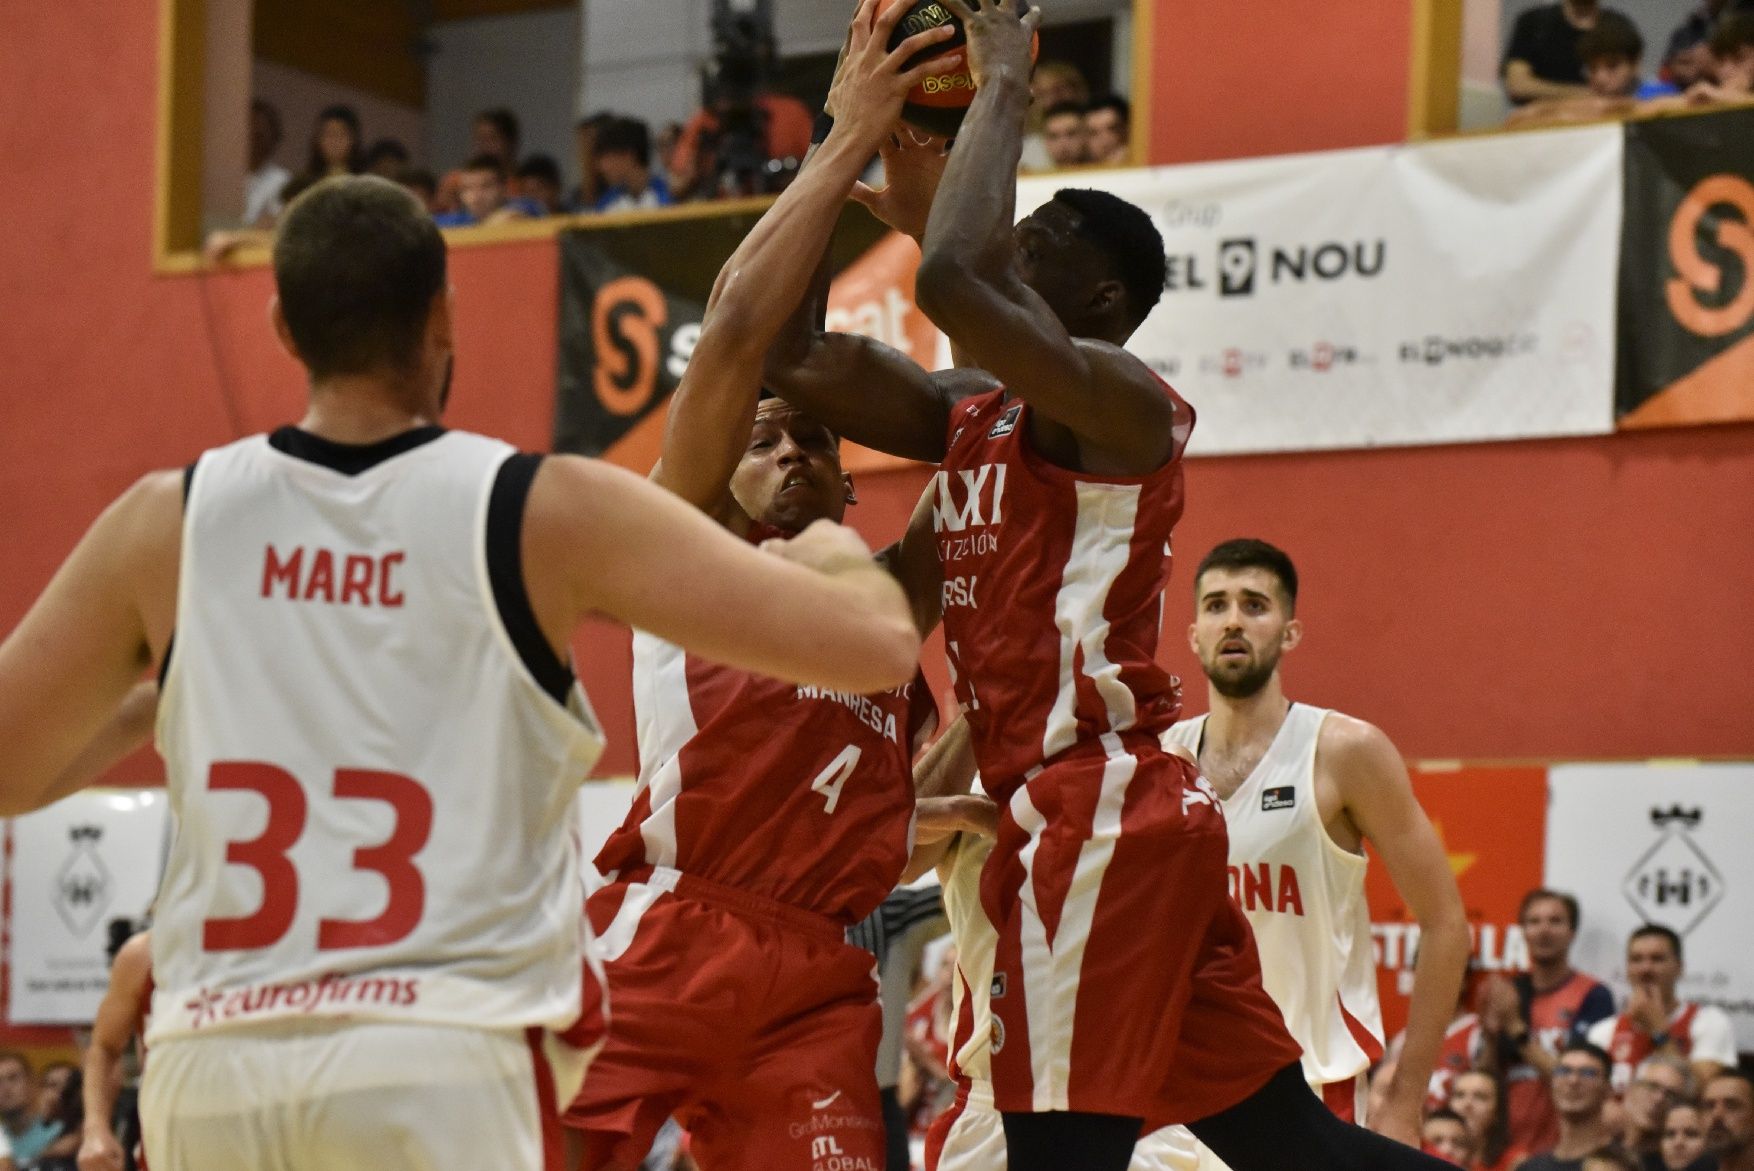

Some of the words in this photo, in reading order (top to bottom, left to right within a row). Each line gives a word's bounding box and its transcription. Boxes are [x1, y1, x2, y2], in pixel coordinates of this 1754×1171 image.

[1271, 239, 1386, 284] NOU
[933, 463, 1007, 533] AXI
[260, 542, 406, 608] MARC
[811, 744, 862, 815] 4
[202, 759, 435, 953] 33
[1226, 862, 1304, 916] ONA
[222, 970, 420, 1018] eurofirms
